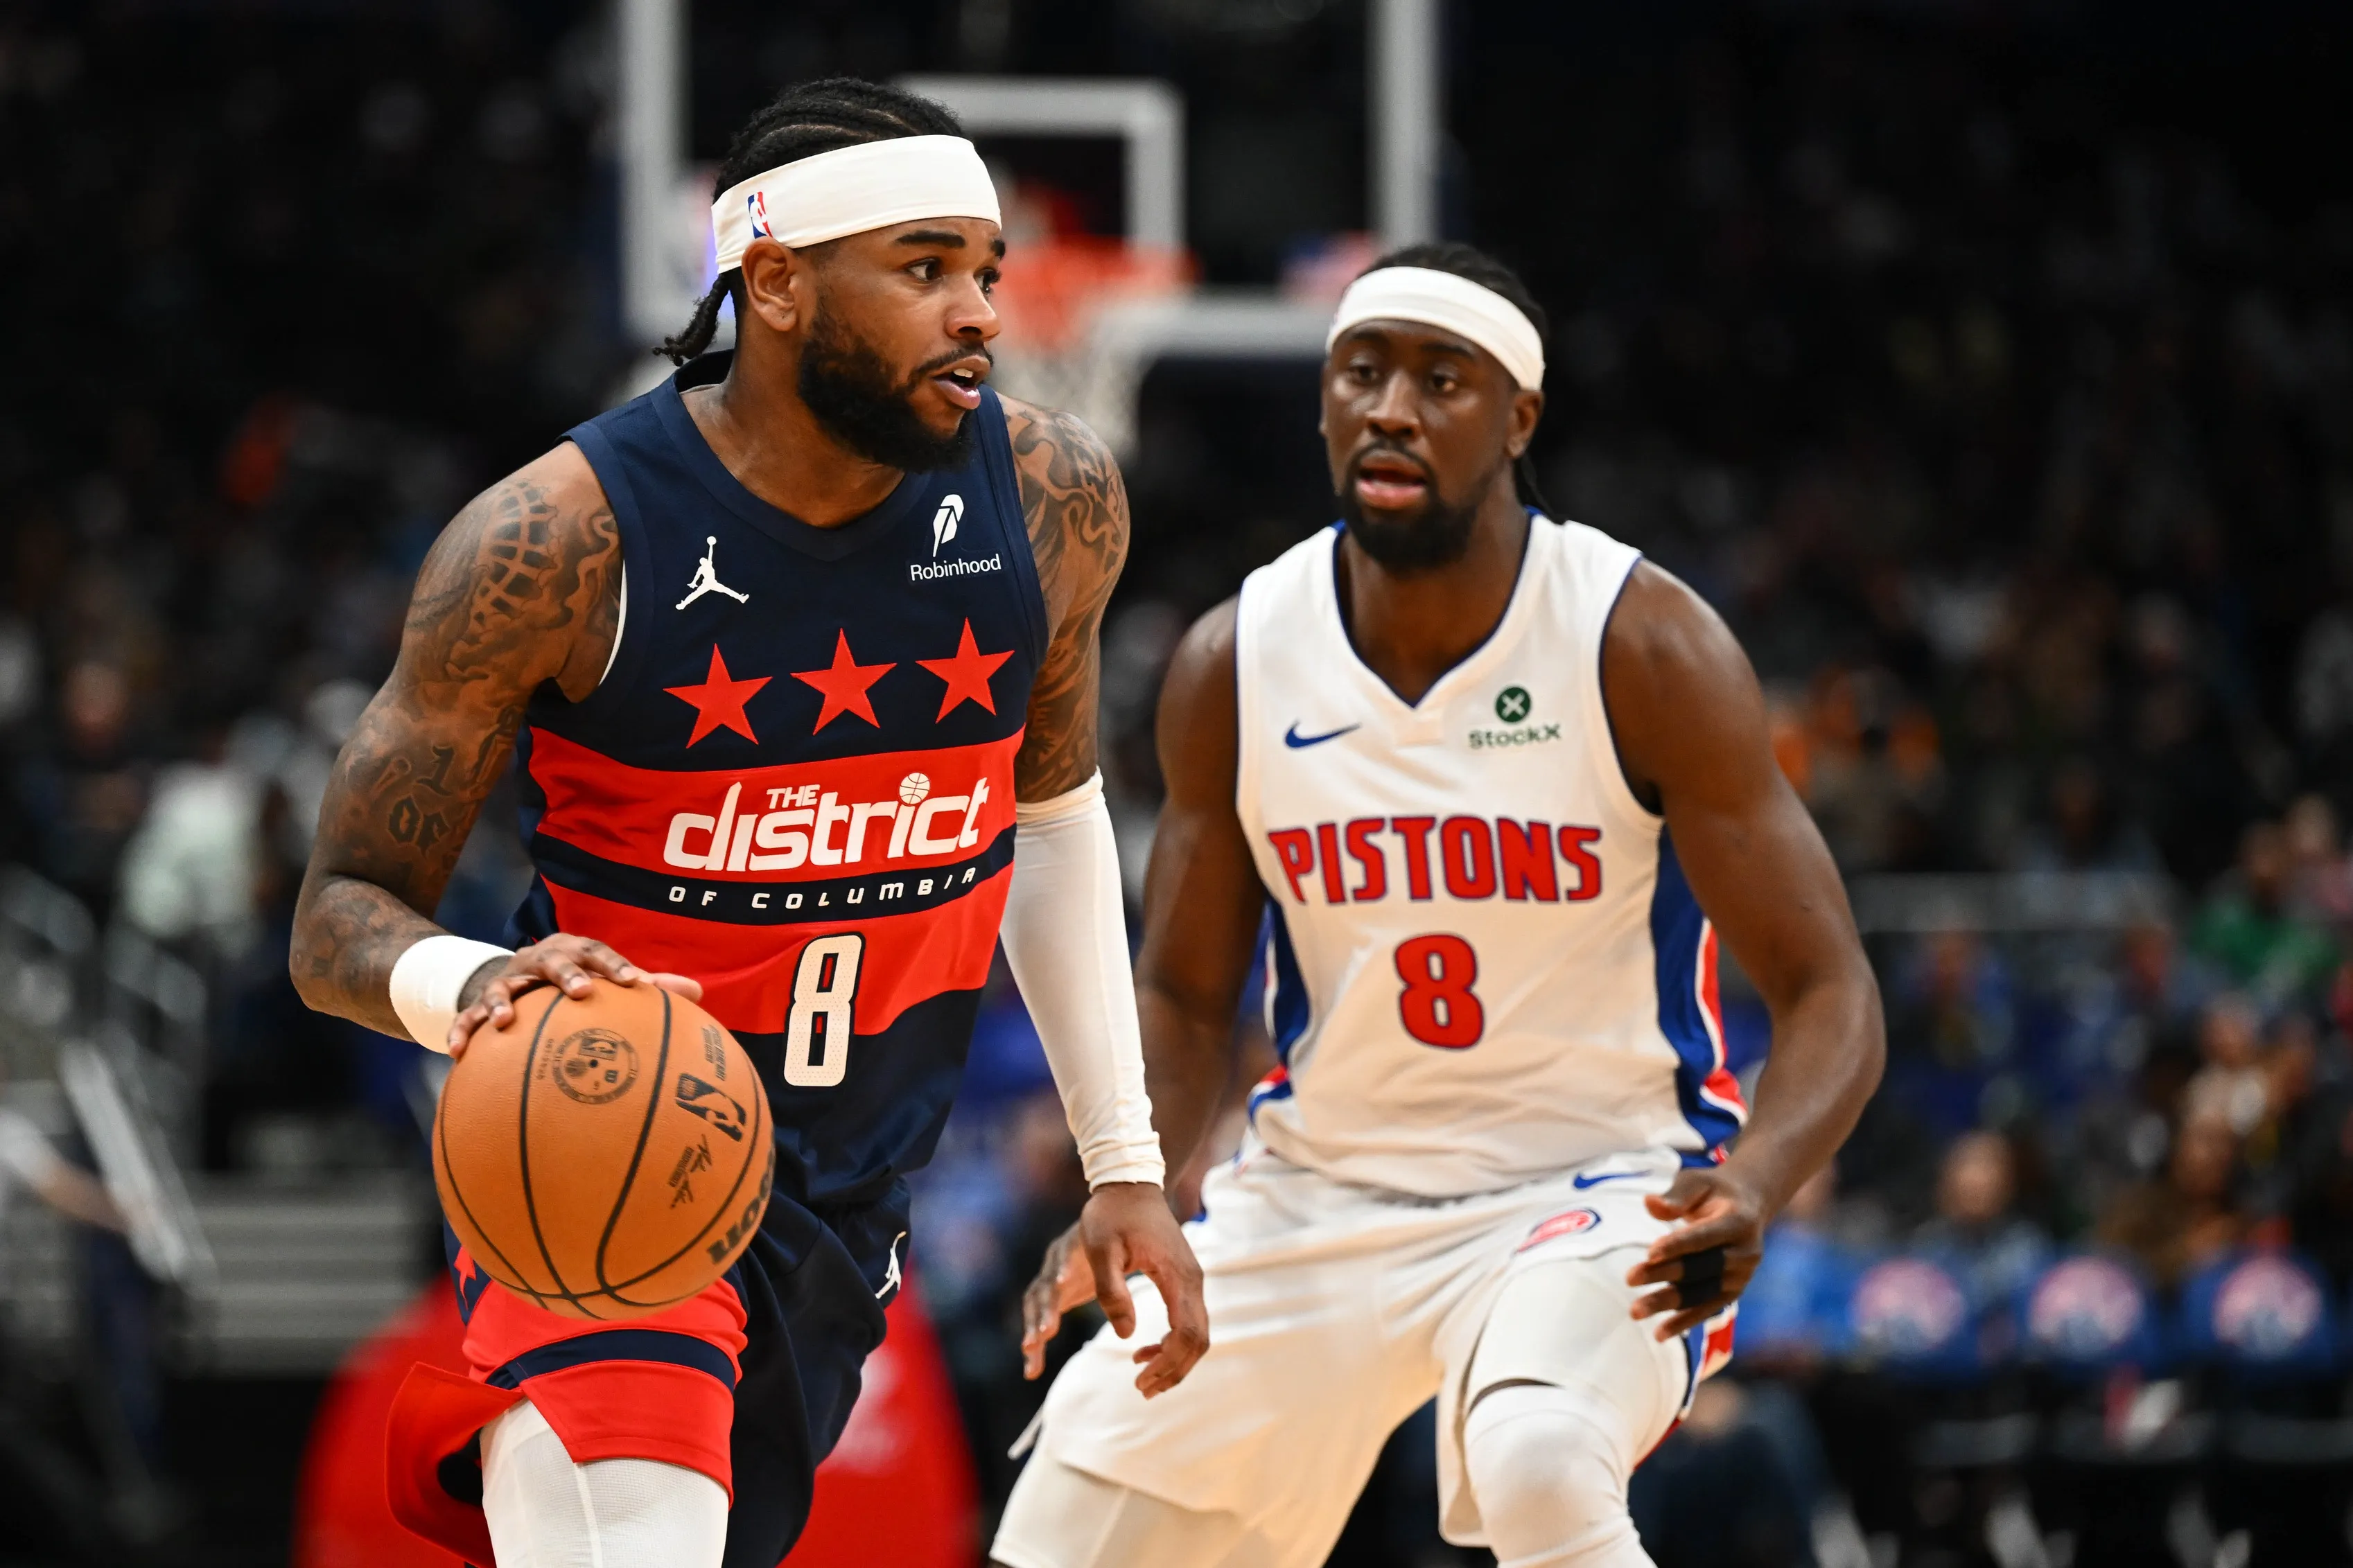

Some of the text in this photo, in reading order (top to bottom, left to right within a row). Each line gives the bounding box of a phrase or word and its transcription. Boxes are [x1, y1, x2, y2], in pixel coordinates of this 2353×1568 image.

[910, 553, 1001, 581] Robinhood
[1469, 724, 1561, 749] StockX
[663, 772, 990, 872] district
[767, 784, 821, 809] THE
[668, 867, 977, 909] OF COLUMBIA
[1268, 816, 1602, 905] PISTONS
[783, 932, 866, 1089] 8
[1393, 933, 1485, 1051] 8
